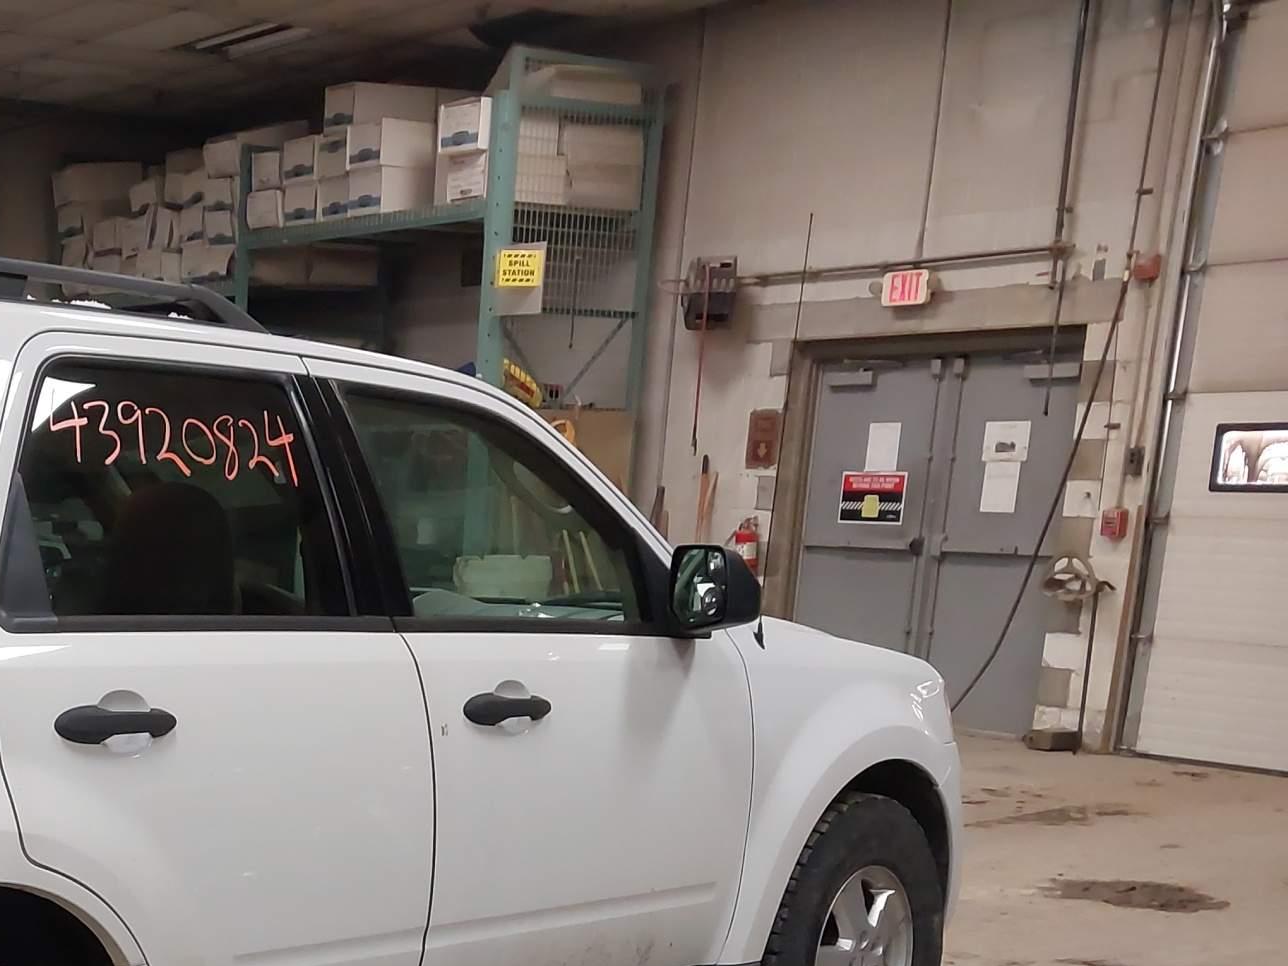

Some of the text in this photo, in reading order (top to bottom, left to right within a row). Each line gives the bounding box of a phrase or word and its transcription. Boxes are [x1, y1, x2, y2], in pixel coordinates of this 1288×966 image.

[502, 269, 535, 277] STATION
[888, 271, 923, 303] EXIT
[50, 388, 299, 488] 43920824
